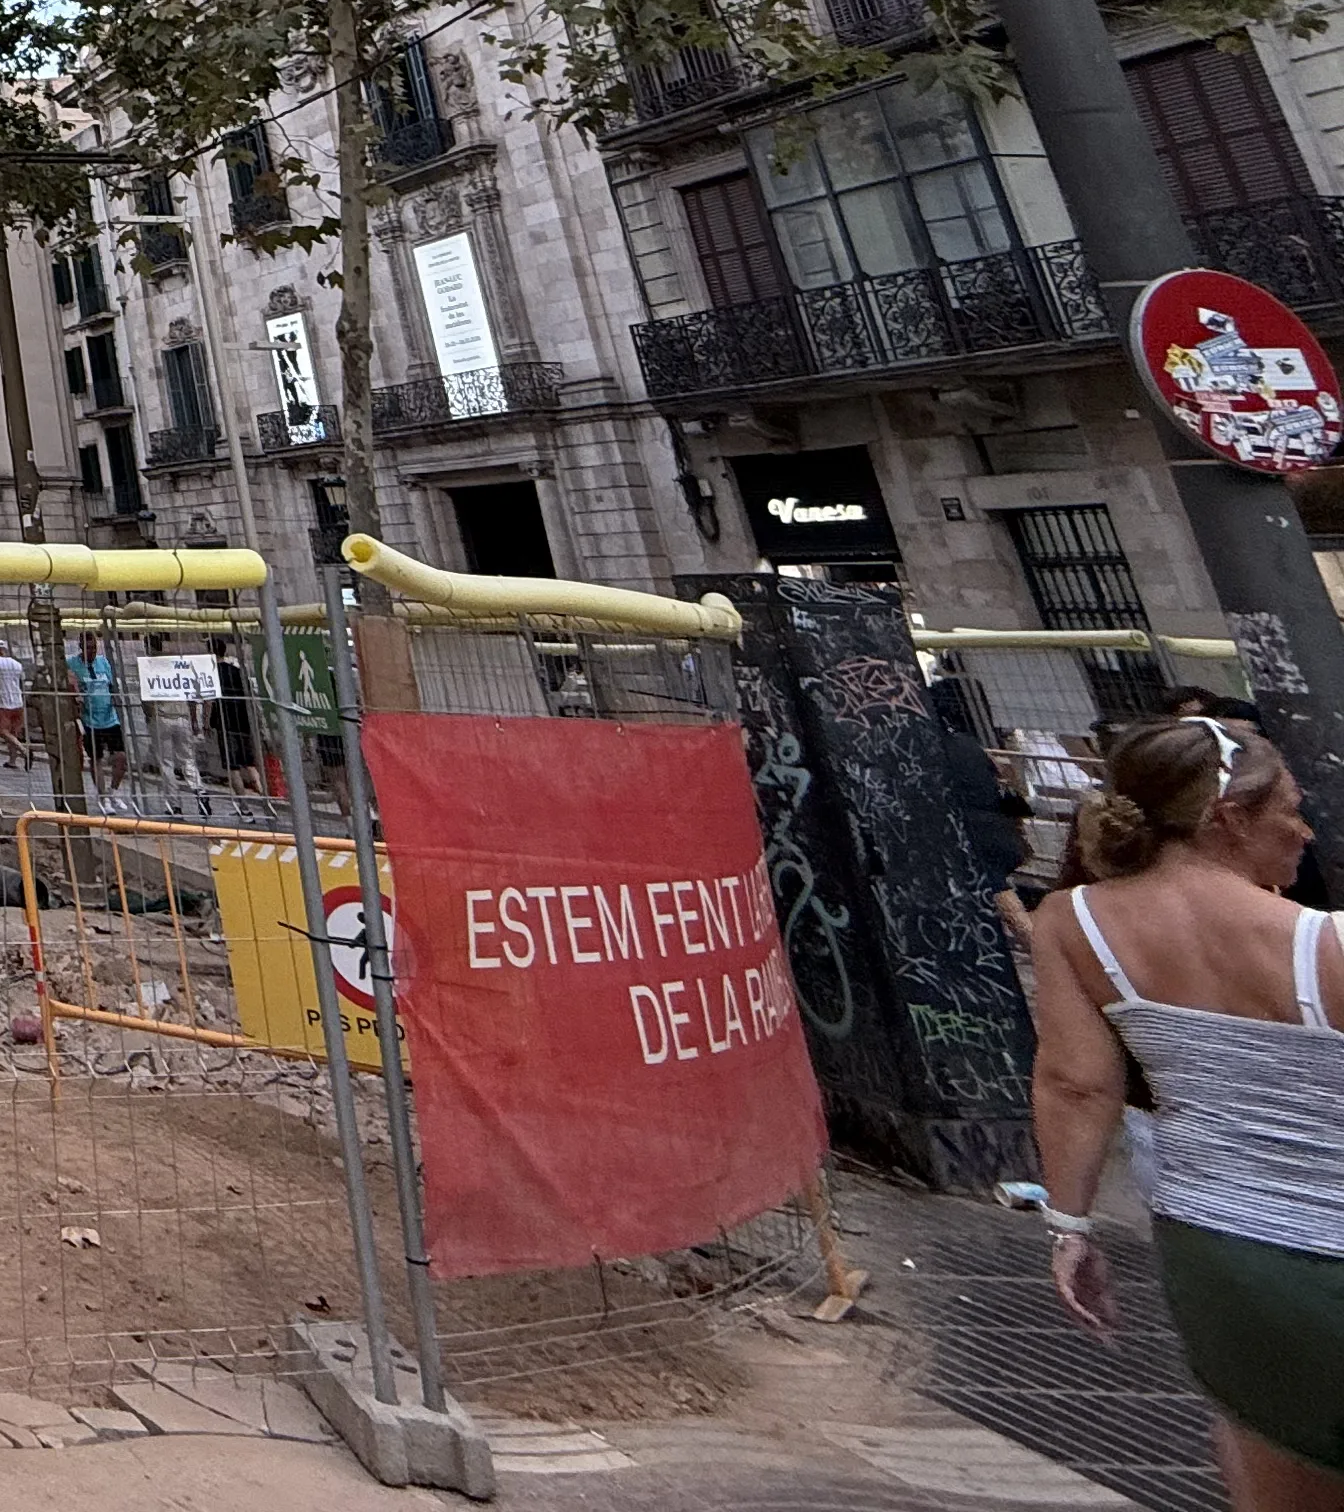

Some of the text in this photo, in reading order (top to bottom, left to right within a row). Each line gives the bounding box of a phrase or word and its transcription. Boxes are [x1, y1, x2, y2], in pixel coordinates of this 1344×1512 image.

[465, 884, 644, 969] ESTEM
[646, 876, 744, 958] FENT
[307, 1008, 351, 1033] PS
[629, 980, 699, 1065] DE
[697, 973, 748, 1054] LA
